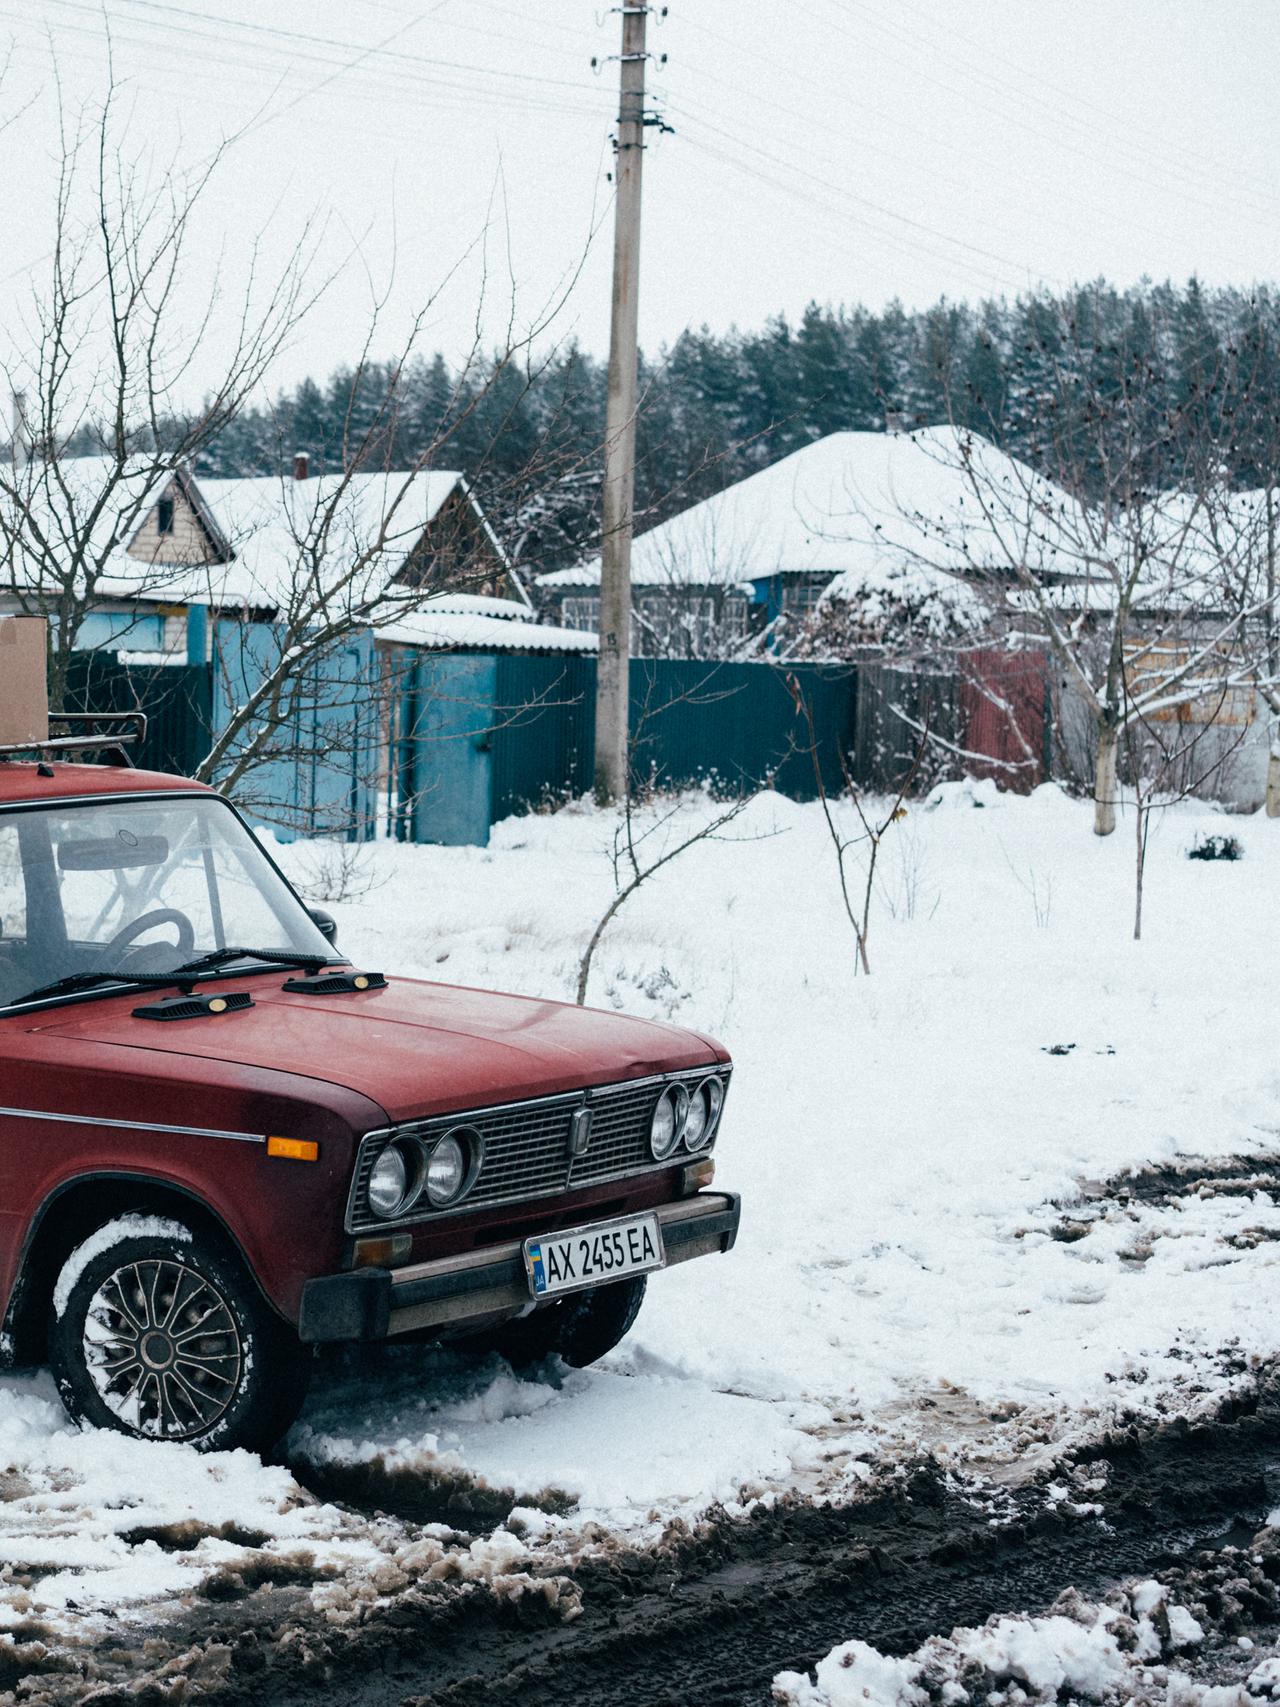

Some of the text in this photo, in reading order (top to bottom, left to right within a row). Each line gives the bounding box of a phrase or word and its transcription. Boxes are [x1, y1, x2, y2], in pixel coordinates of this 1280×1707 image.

[548, 1226, 655, 1283] AX 2455 EA
